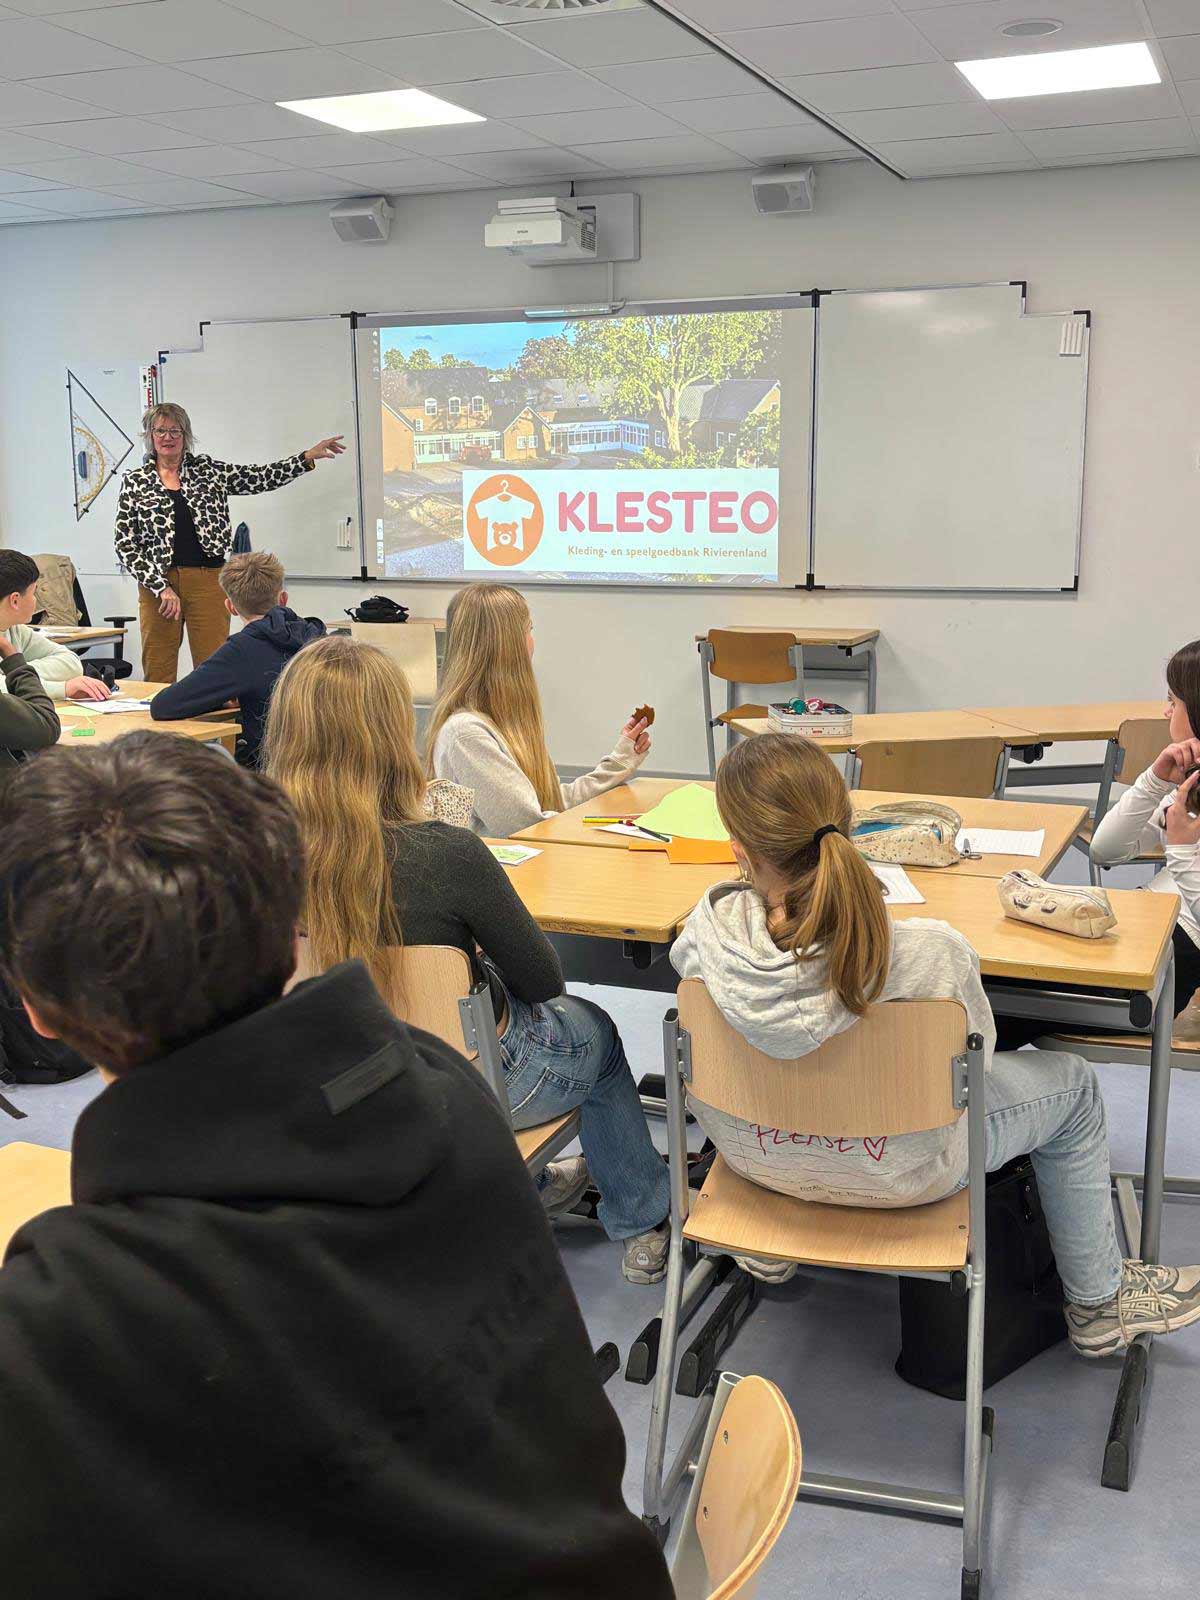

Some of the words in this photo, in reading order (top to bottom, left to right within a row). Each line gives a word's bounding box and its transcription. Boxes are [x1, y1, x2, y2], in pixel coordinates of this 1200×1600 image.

[558, 491, 778, 534] KLESTEO
[567, 546, 608, 558] Kleding-
[611, 548, 623, 556] en
[626, 547, 700, 559] speelgoedbank
[703, 547, 767, 558] Rivierenland
